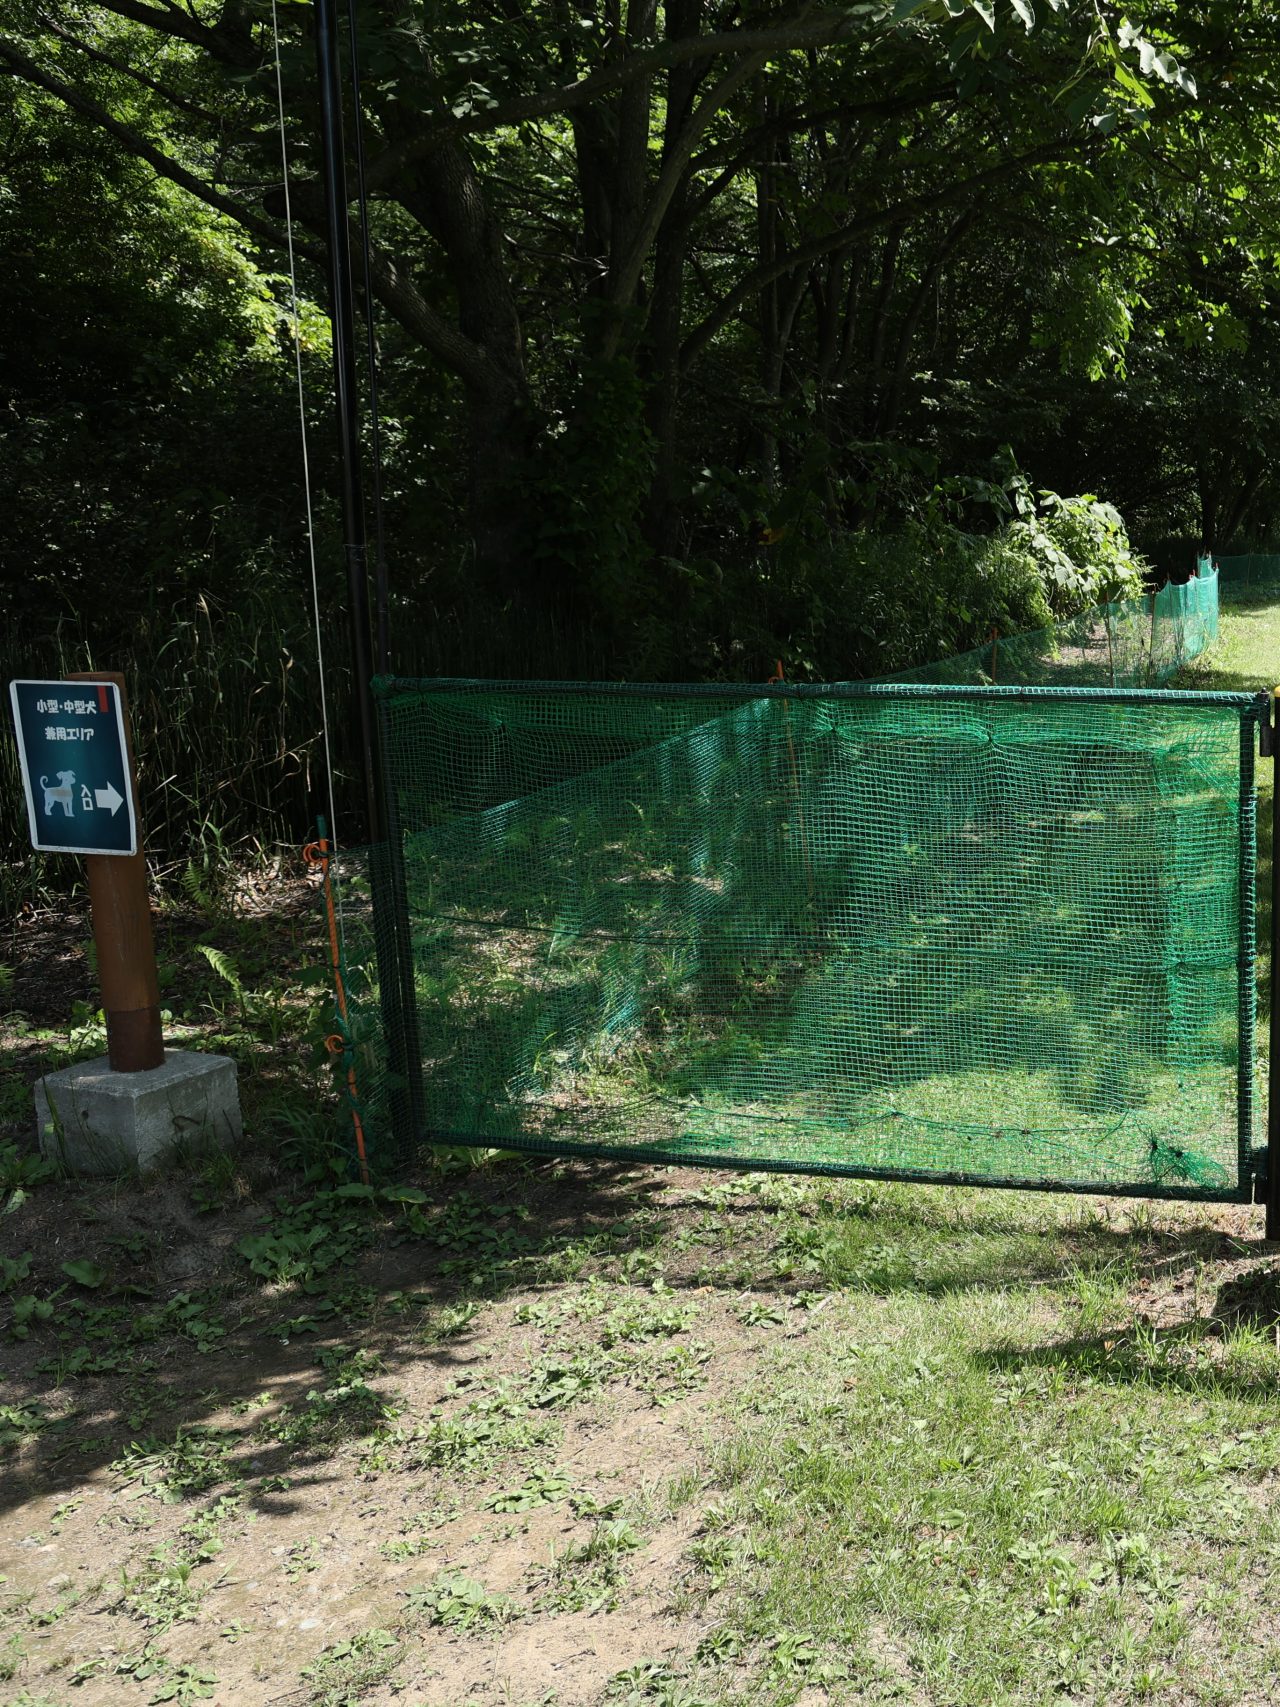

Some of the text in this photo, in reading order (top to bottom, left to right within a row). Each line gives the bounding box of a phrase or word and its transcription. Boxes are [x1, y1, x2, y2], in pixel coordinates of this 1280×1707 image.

[37, 699, 97, 715] 小型・中型犬
[44, 726, 95, 741] 兼用エリア
[81, 784, 94, 811] 入口
